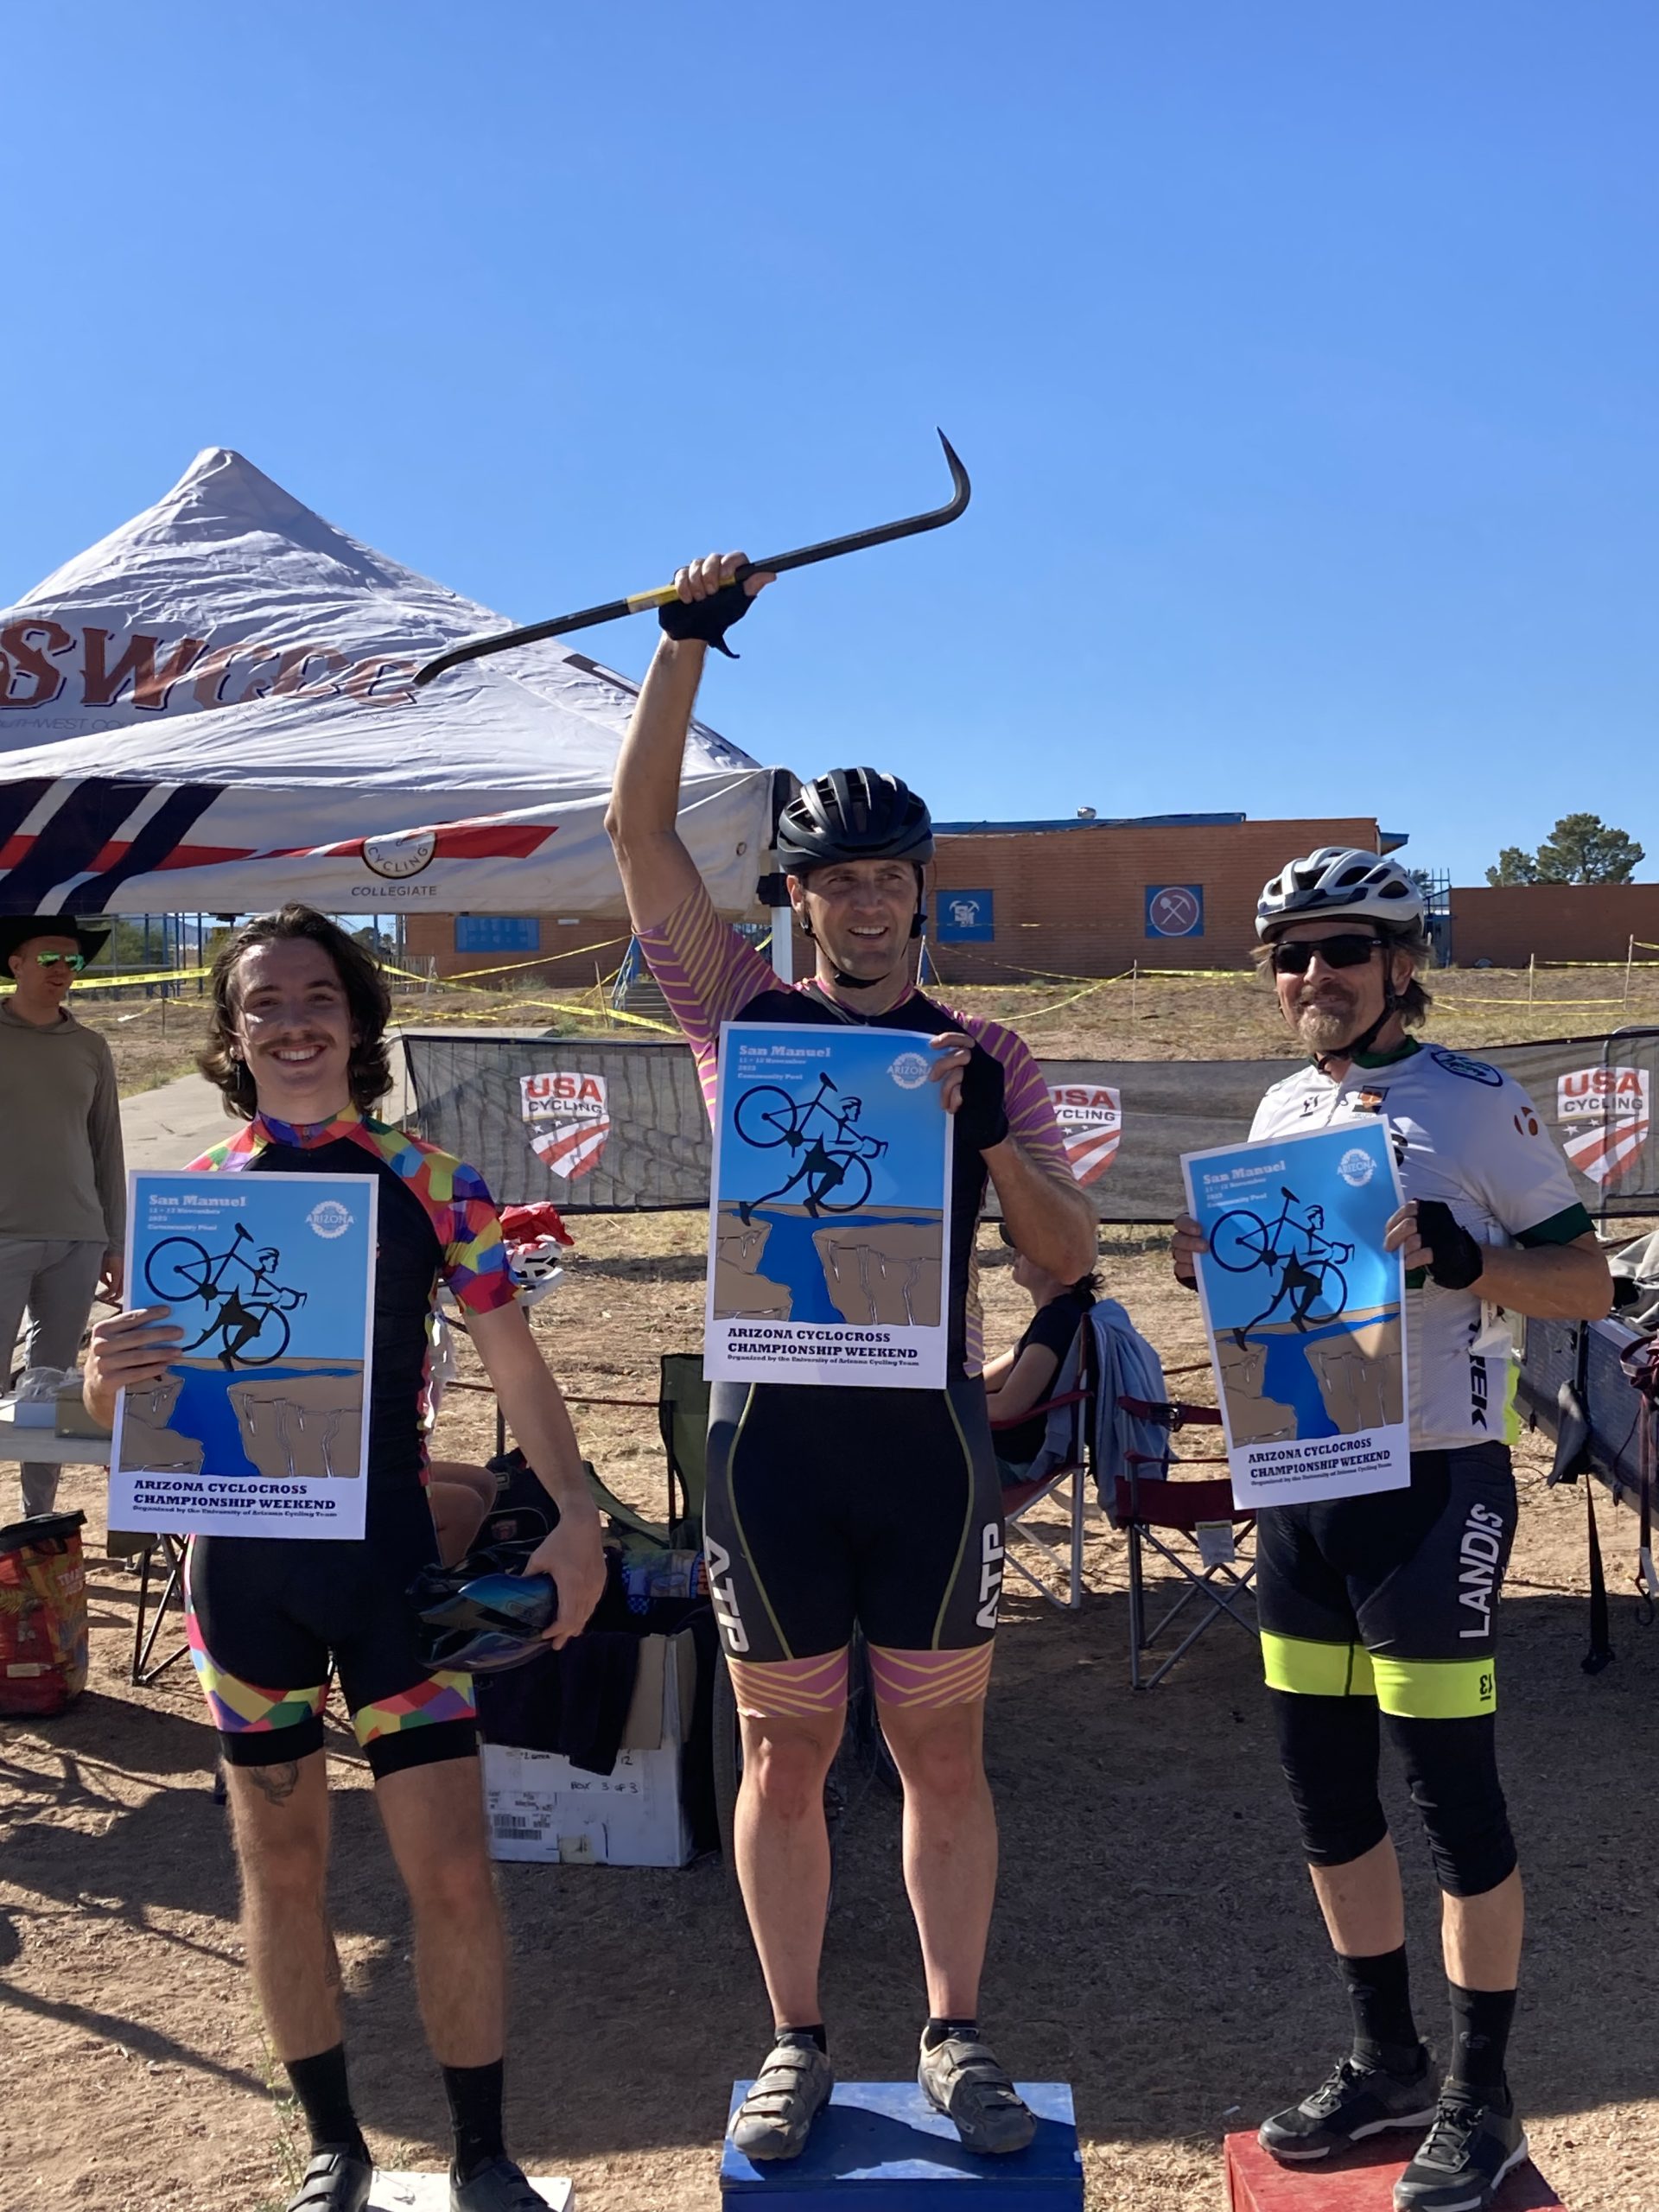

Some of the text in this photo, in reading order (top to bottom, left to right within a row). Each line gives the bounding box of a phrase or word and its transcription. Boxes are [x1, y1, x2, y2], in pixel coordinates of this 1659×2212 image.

[367, 847, 428, 872] CYCLING
[351, 886, 438, 897] COLLEGIATE
[739, 1045, 831, 1058] San Manuel
[526, 1077, 603, 1103] USA
[1565, 1069, 1643, 1097] USA
[528, 1100, 603, 1115] CYCLING
[1564, 1097, 1643, 1113] CYCLING
[1054, 1109, 1116, 1122] YCLING
[1203, 1160, 1286, 1185] San Manuel
[1337, 1159, 1377, 1176] ARIZONA
[149, 1194, 246, 1207] San Manuel
[304, 1213, 354, 1224] ARIZONA
[728, 1328, 891, 1343] ARIZONA CYCLOCROSS
[728, 1342, 918, 1358] CHAMPIONSHIP WEEKEND
[791, 1356, 828, 1364] University
[1249, 1438, 1372, 1464] ARIZONA CYCLOCROSS
[1250, 1450, 1390, 1478] CHAMPIONSHIP WEEKEND
[134, 1479, 308, 1495] ARIZONA CYCLOCROSS
[133, 1494, 336, 1510] CHAMPIONSHIP WEEKEND
[976, 1522, 1004, 1629] ATP
[1459, 1503, 1503, 1638] LANDIS
[705, 1535, 750, 1653] ATP
[601, 1782, 609, 1790] 3
[629, 1782, 639, 1794] 3
